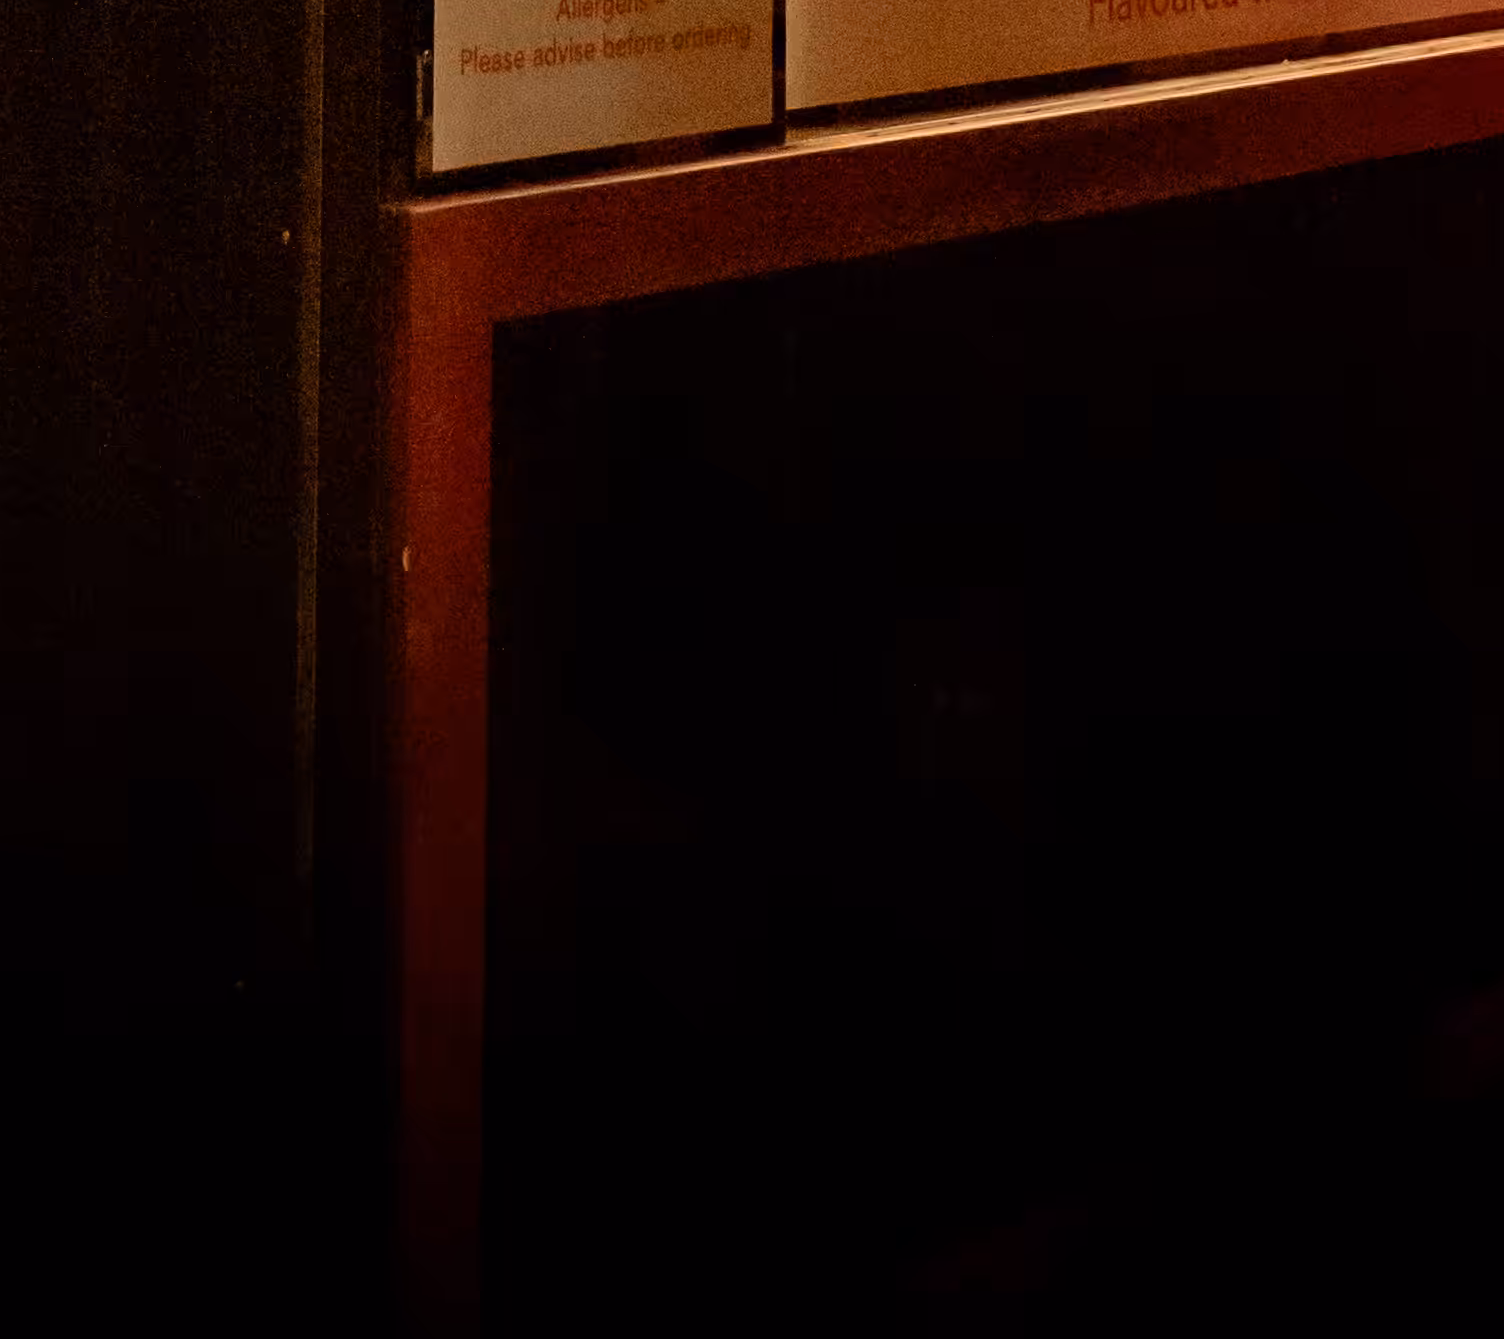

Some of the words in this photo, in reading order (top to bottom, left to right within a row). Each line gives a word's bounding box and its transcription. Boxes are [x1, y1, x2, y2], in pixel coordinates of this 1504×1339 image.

[461, 46, 524, 75] Please
[533, 36, 595, 67] advise
[602, 26, 665, 58] before
[672, 20, 751, 52] ordering
